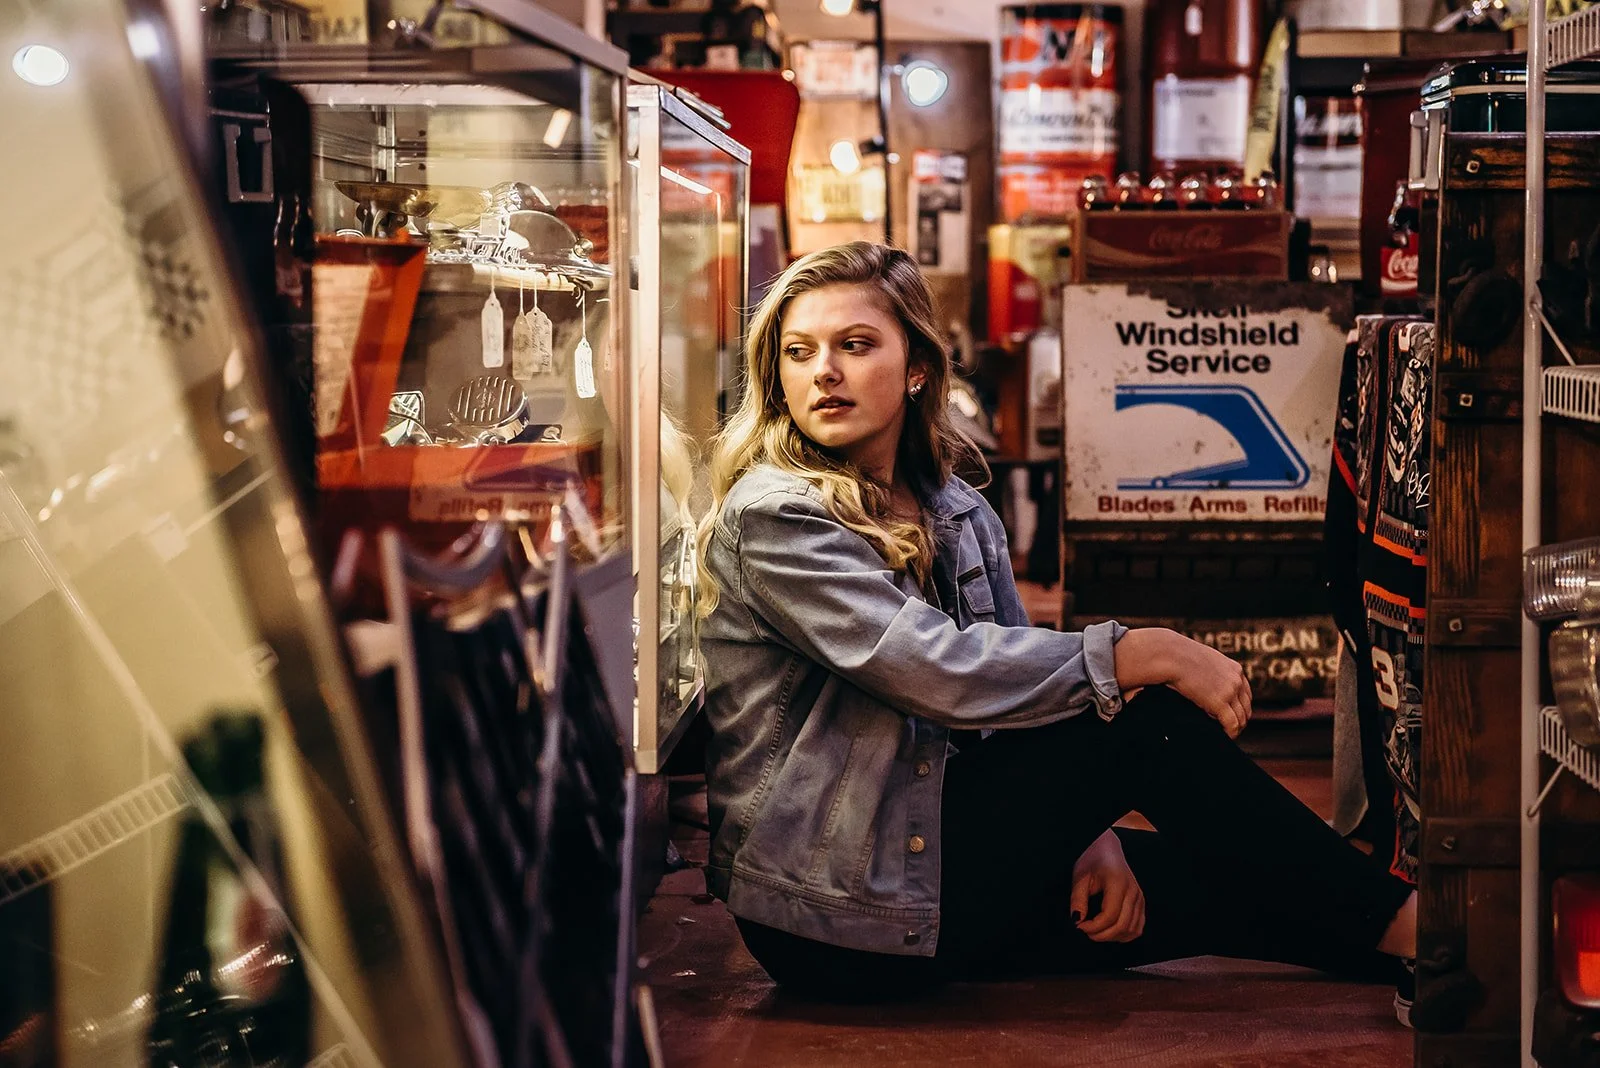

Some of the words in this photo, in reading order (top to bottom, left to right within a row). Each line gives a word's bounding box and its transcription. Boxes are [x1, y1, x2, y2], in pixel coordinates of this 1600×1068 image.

[1115, 321, 1299, 346] Windshield
[1146, 349, 1272, 375] Service
[1097, 495, 1175, 513] Blades
[1188, 496, 1248, 513] Arms
[1370, 645, 1399, 711] 3
